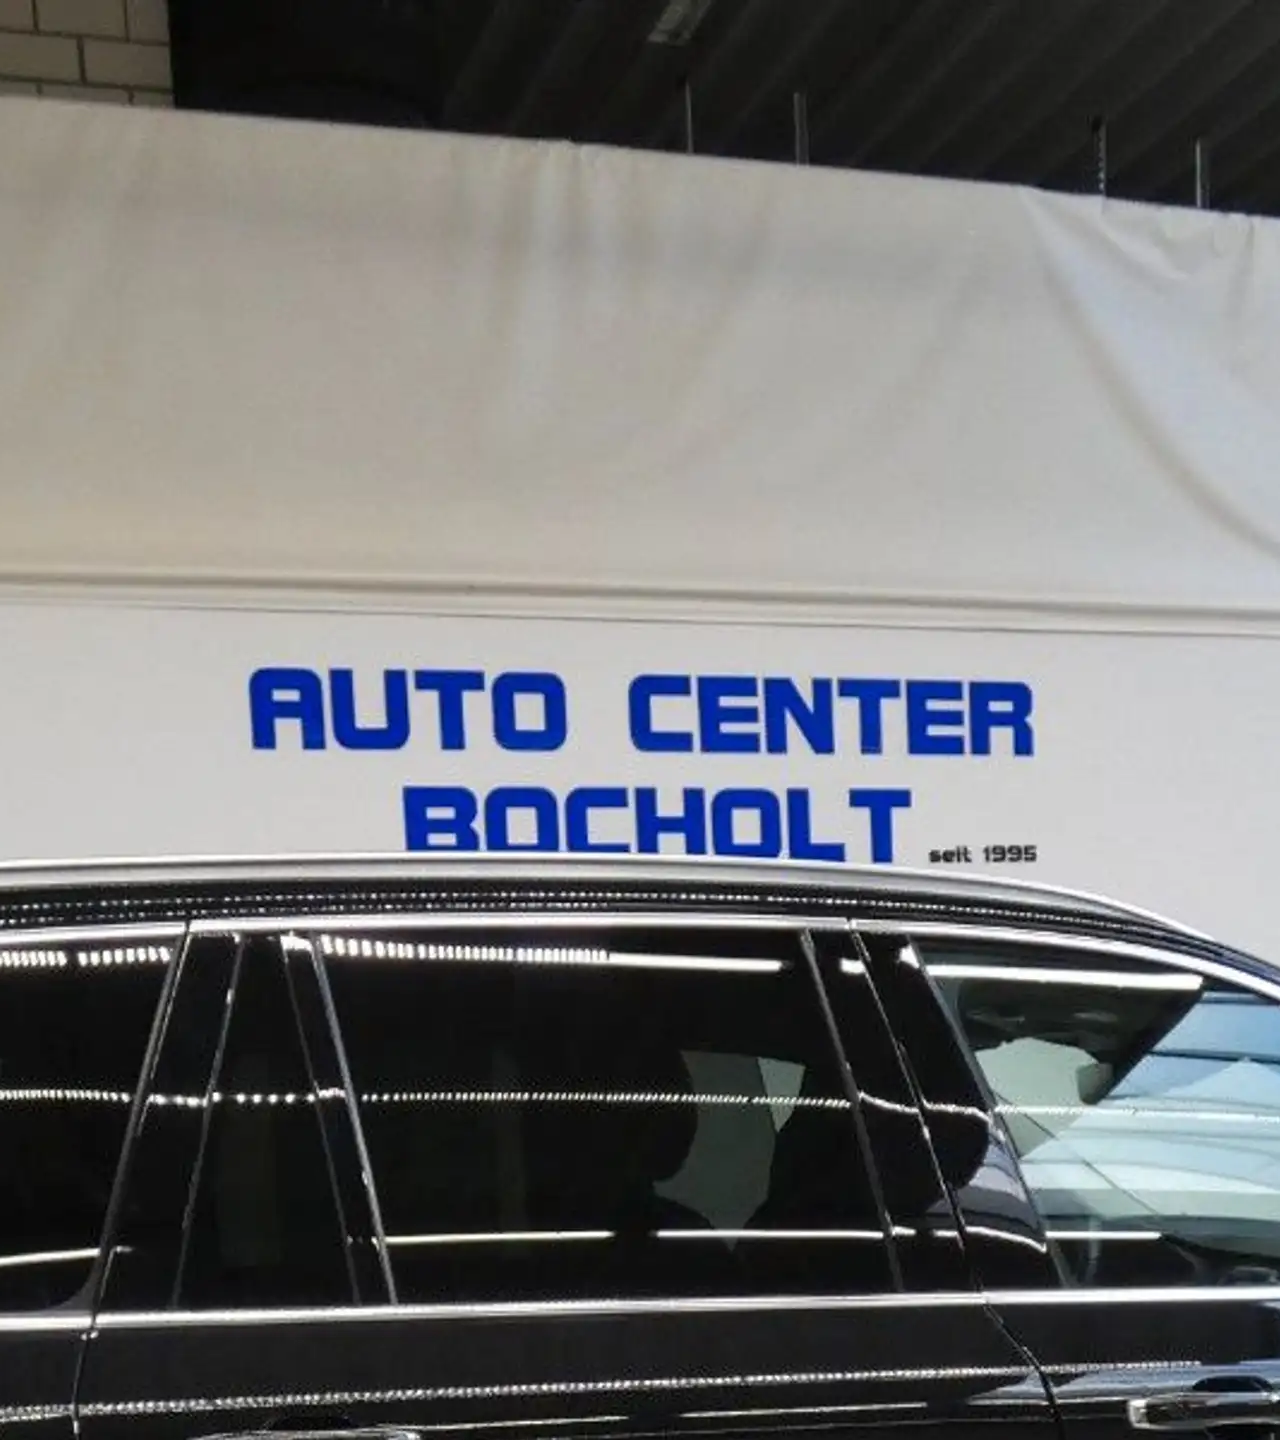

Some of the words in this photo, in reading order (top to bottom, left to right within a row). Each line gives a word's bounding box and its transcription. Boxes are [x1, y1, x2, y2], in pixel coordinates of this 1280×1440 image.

[248, 667, 568, 752] AUTO
[628, 674, 1036, 758] CENTER
[402, 785, 912, 863] BOCHOLT
[928, 845, 973, 863] seit
[982, 844, 1038, 863] 1995
